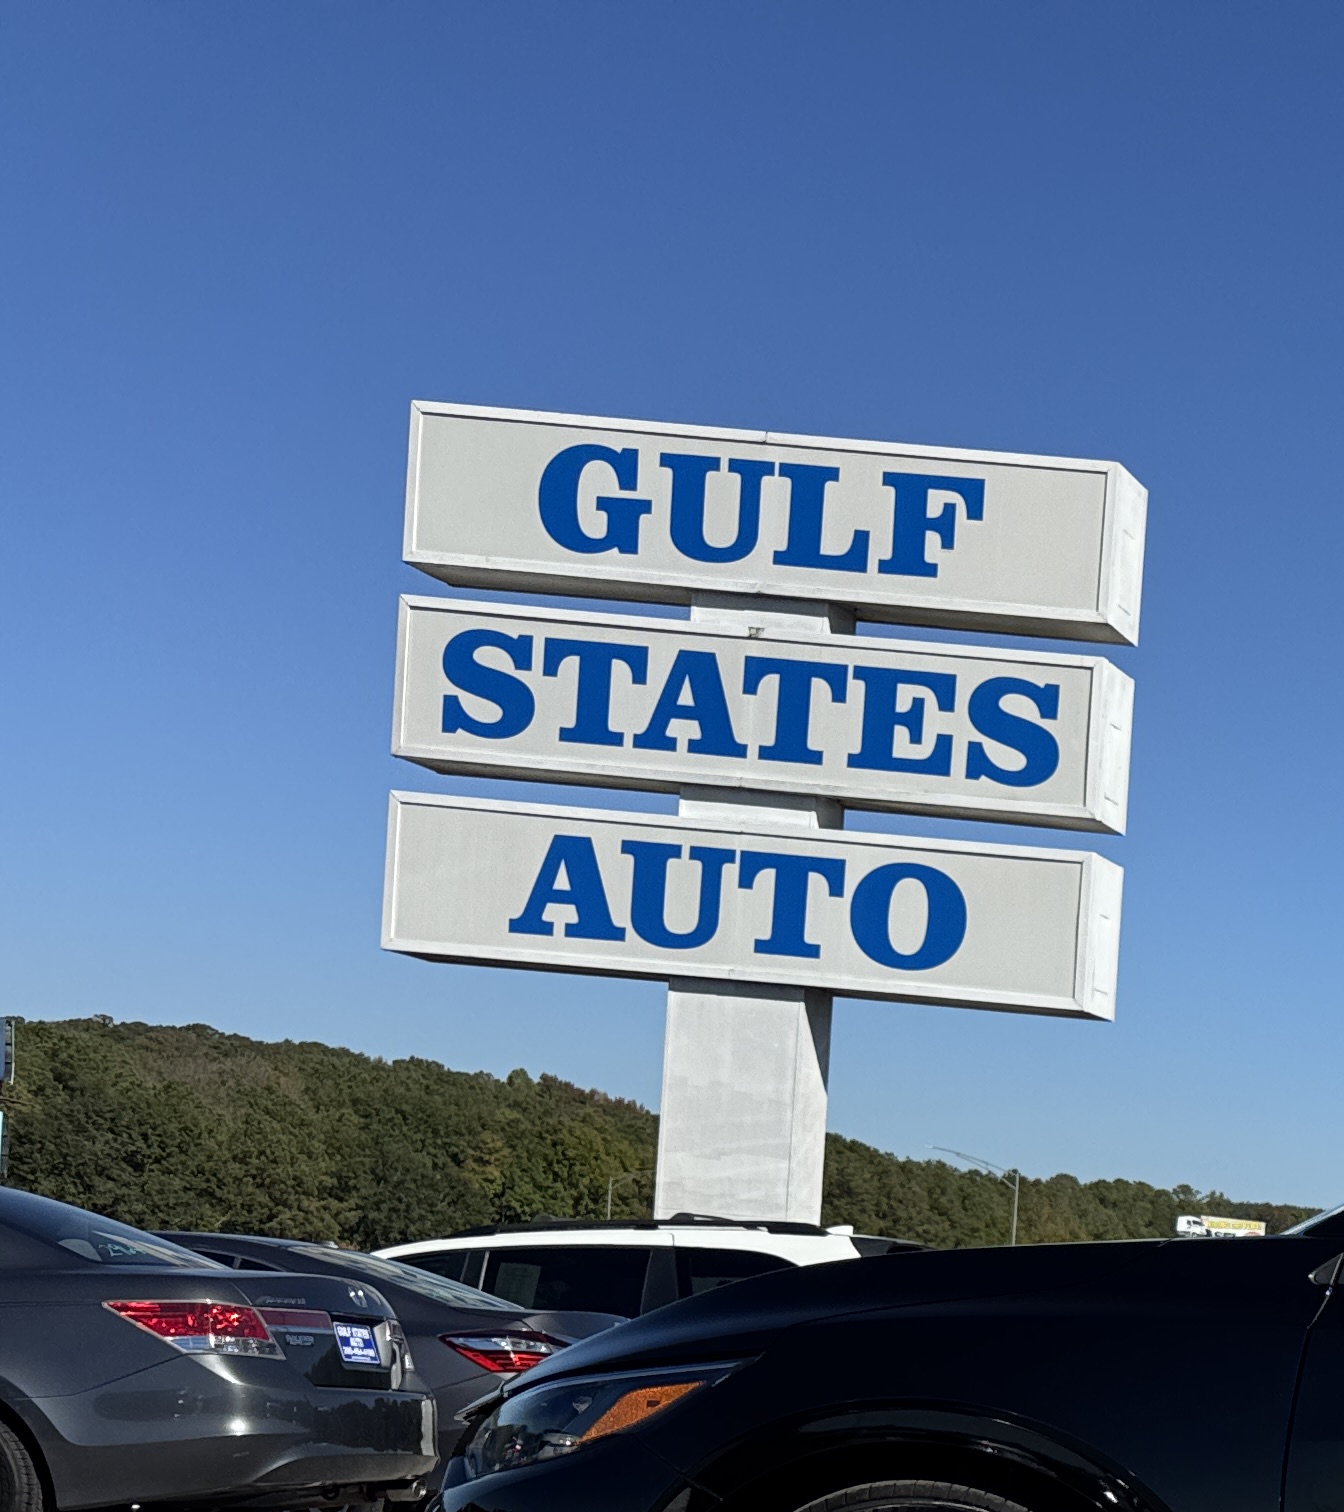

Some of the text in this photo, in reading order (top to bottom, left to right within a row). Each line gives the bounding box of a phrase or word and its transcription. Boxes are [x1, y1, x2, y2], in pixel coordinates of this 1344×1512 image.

[538, 443, 986, 578] GULF
[441, 628, 1061, 788] STATES
[507, 833, 968, 972] AUTO
